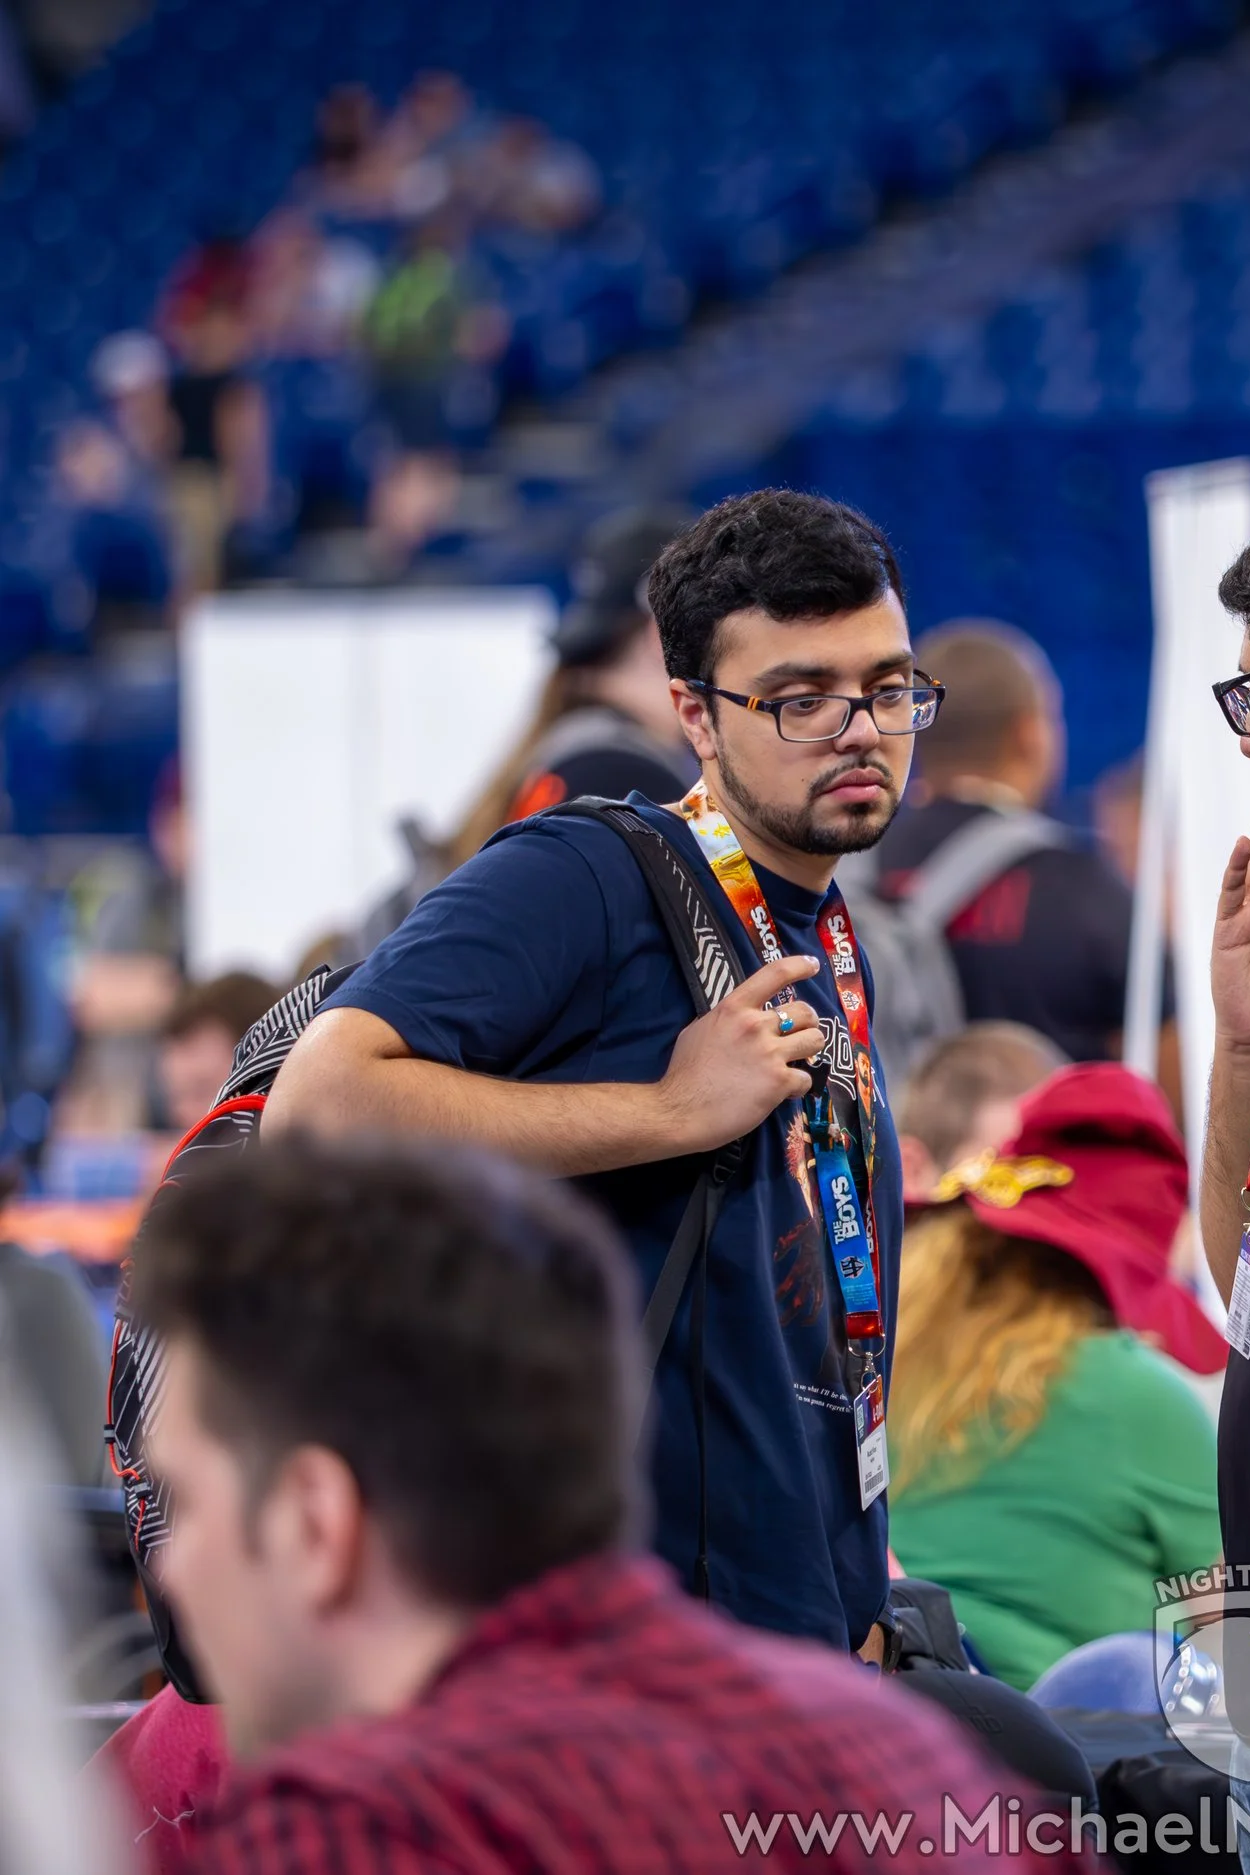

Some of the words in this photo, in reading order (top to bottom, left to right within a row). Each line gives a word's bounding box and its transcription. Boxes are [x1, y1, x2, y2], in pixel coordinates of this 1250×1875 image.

[750, 905, 782, 964] BOYS
[828, 914, 857, 974] BOYS
[832, 954, 845, 977] THE
[831, 1175, 860, 1239] BOYS
[833, 1220, 845, 1245] THE
